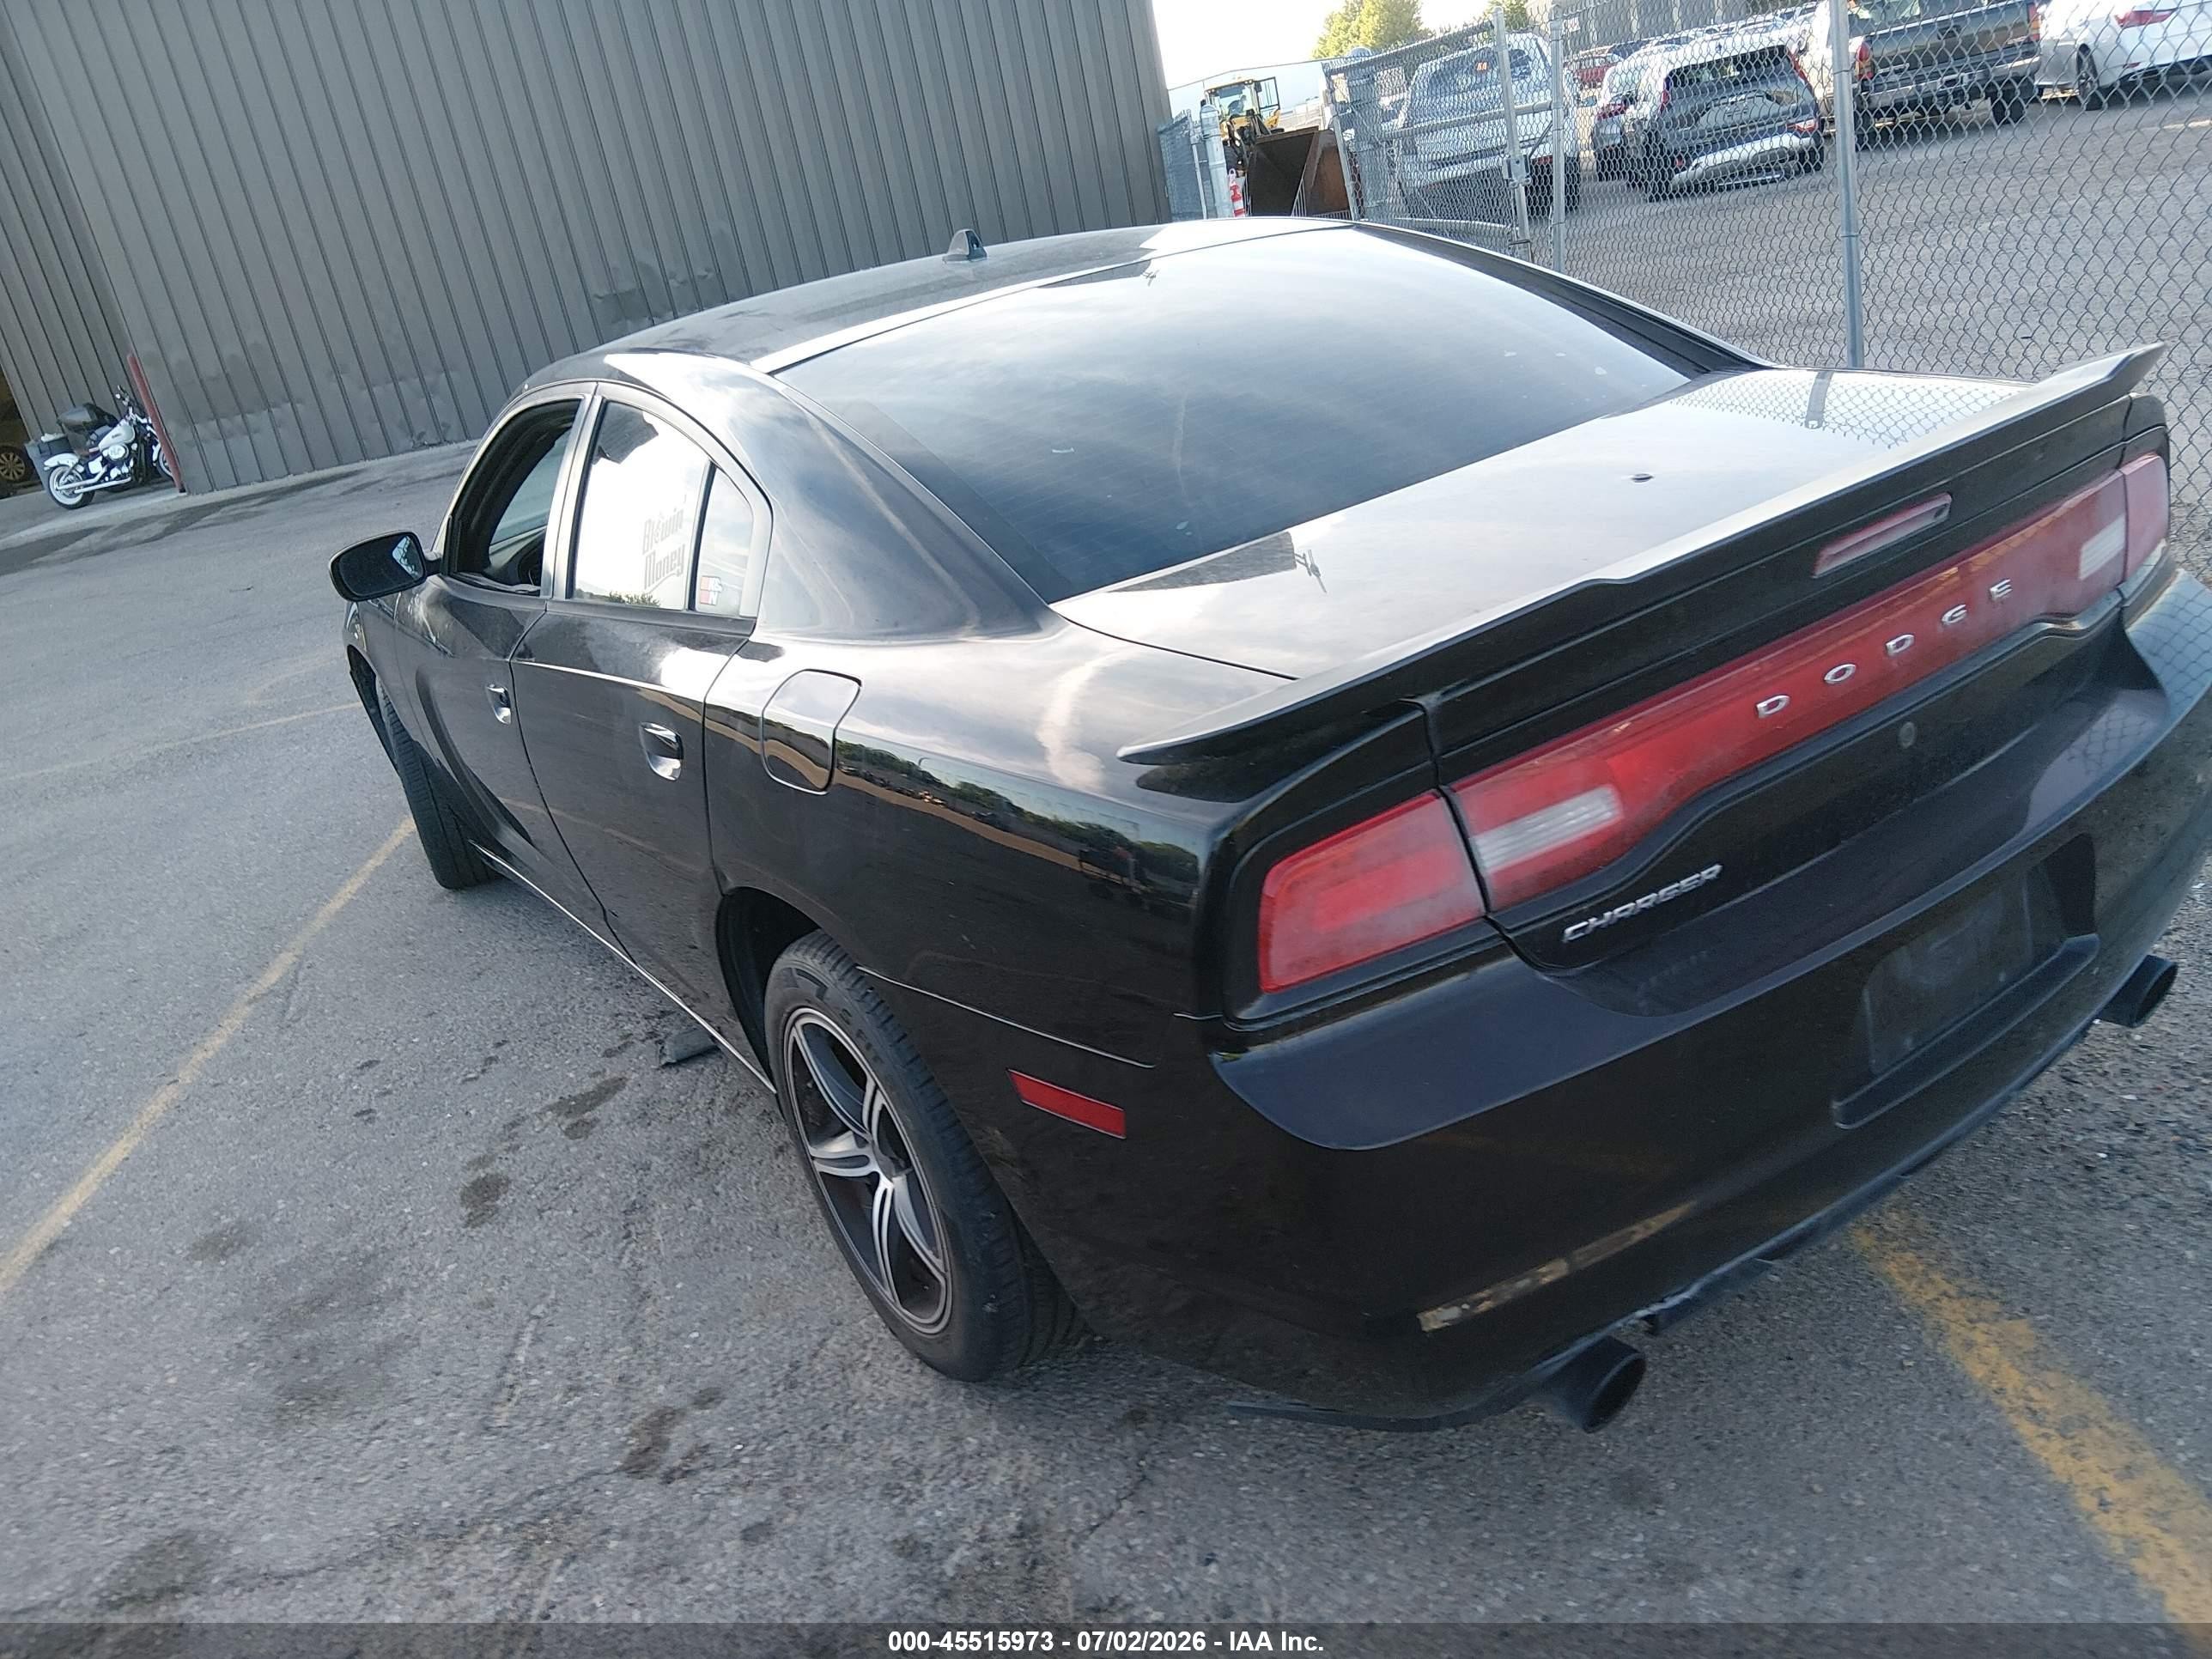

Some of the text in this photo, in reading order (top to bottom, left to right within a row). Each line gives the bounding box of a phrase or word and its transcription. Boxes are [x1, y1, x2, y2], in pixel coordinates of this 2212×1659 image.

[643, 543, 686, 591] Money
[1756, 578, 2013, 718] DODGE
[1562, 864, 1723, 942] CHARGER
